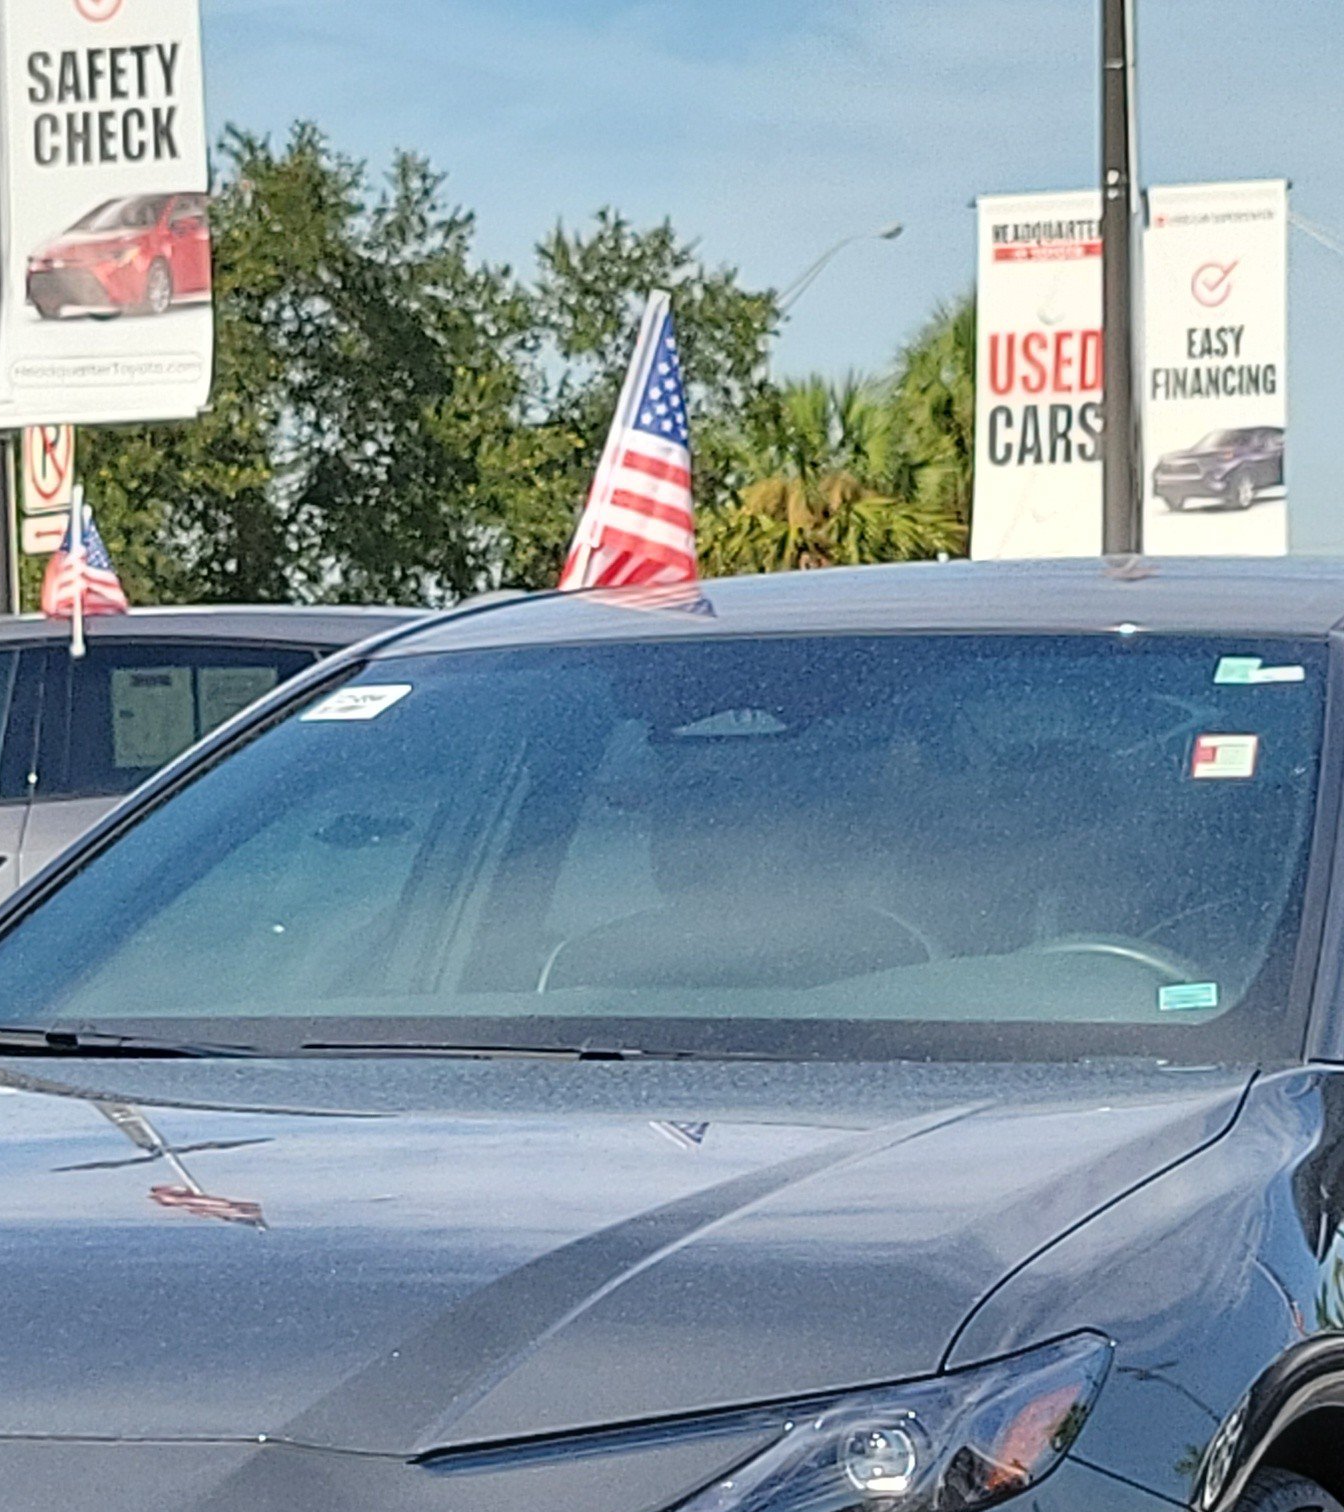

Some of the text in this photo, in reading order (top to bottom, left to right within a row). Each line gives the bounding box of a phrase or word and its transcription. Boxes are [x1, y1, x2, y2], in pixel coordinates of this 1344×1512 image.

[27, 43, 179, 103] SAFETY
[33, 106, 179, 165] CHECK
[988, 330, 1103, 396] USED
[1187, 324, 1244, 358] EASY
[1152, 364, 1277, 400] FINANCING
[988, 402, 1103, 466] CARS
